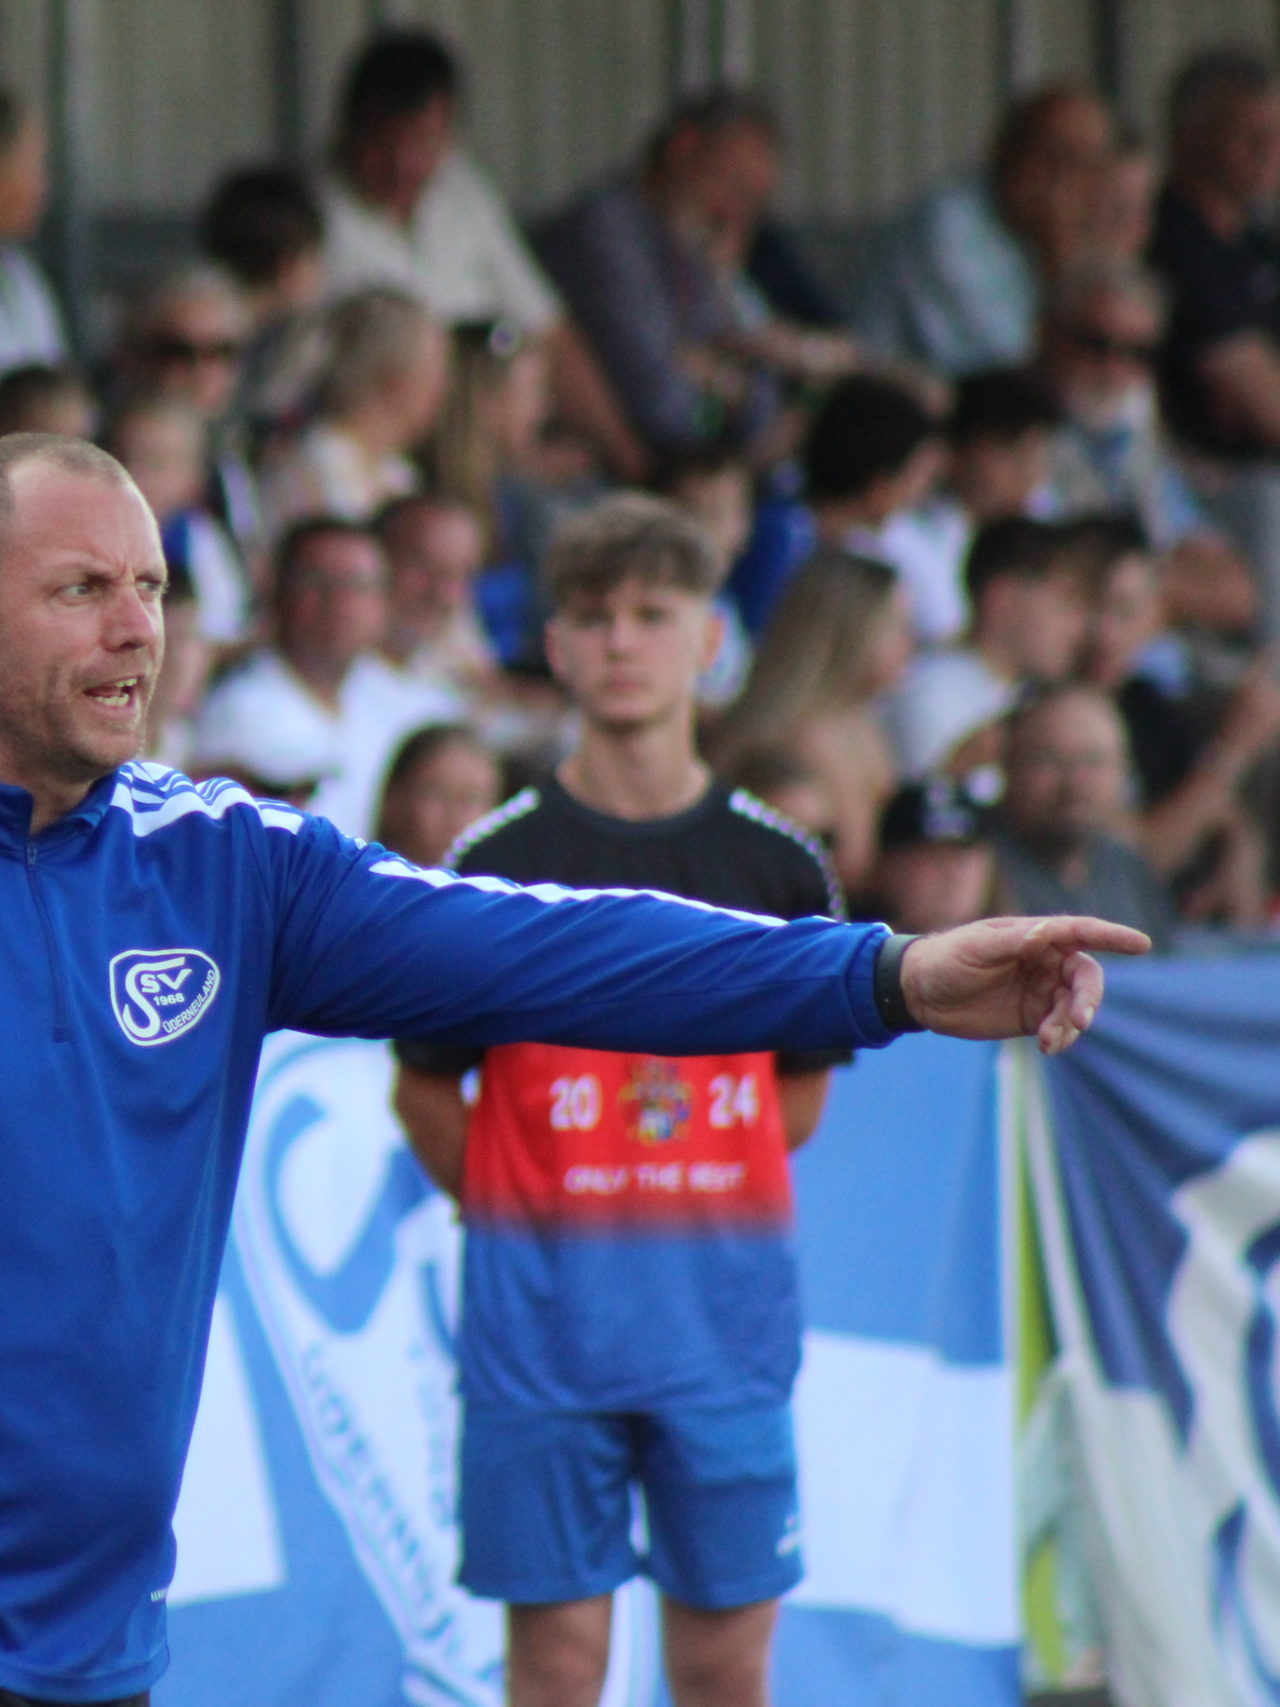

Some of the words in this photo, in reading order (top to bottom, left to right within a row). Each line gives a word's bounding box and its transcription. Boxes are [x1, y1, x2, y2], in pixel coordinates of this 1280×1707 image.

[140, 968, 192, 993] SV
[153, 993, 185, 1006] 1968
[548, 1073, 602, 1131] 20
[707, 1073, 759, 1129] 24
[635, 1162, 683, 1193] THE
